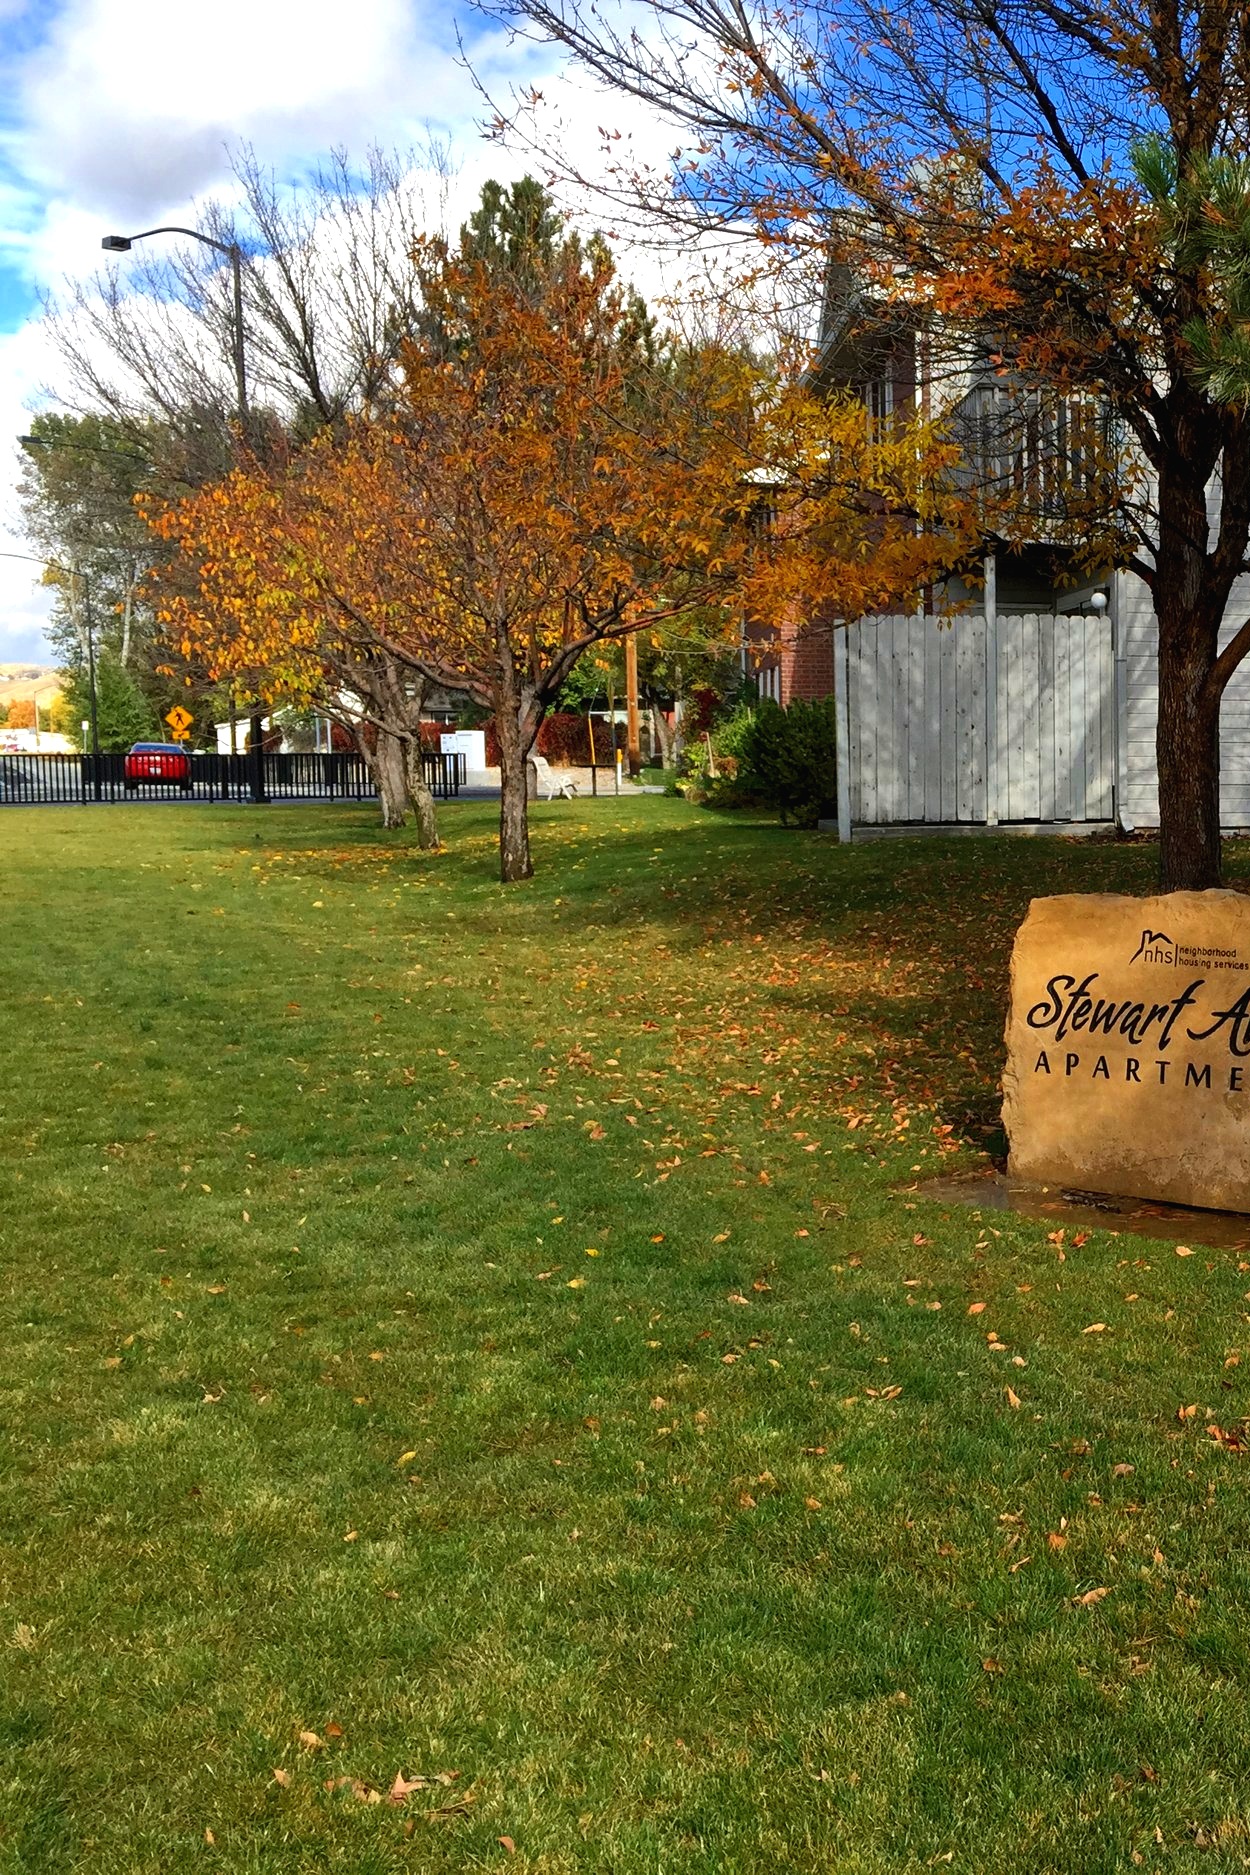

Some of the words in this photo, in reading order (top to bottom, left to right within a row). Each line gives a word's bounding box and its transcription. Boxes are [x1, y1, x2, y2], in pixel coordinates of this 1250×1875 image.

[1144, 945, 1173, 964] nhs
[1179, 946, 1237, 958] neighborhood
[1213, 960, 1249, 971] services
[1026, 973, 1205, 1052] Stewart
